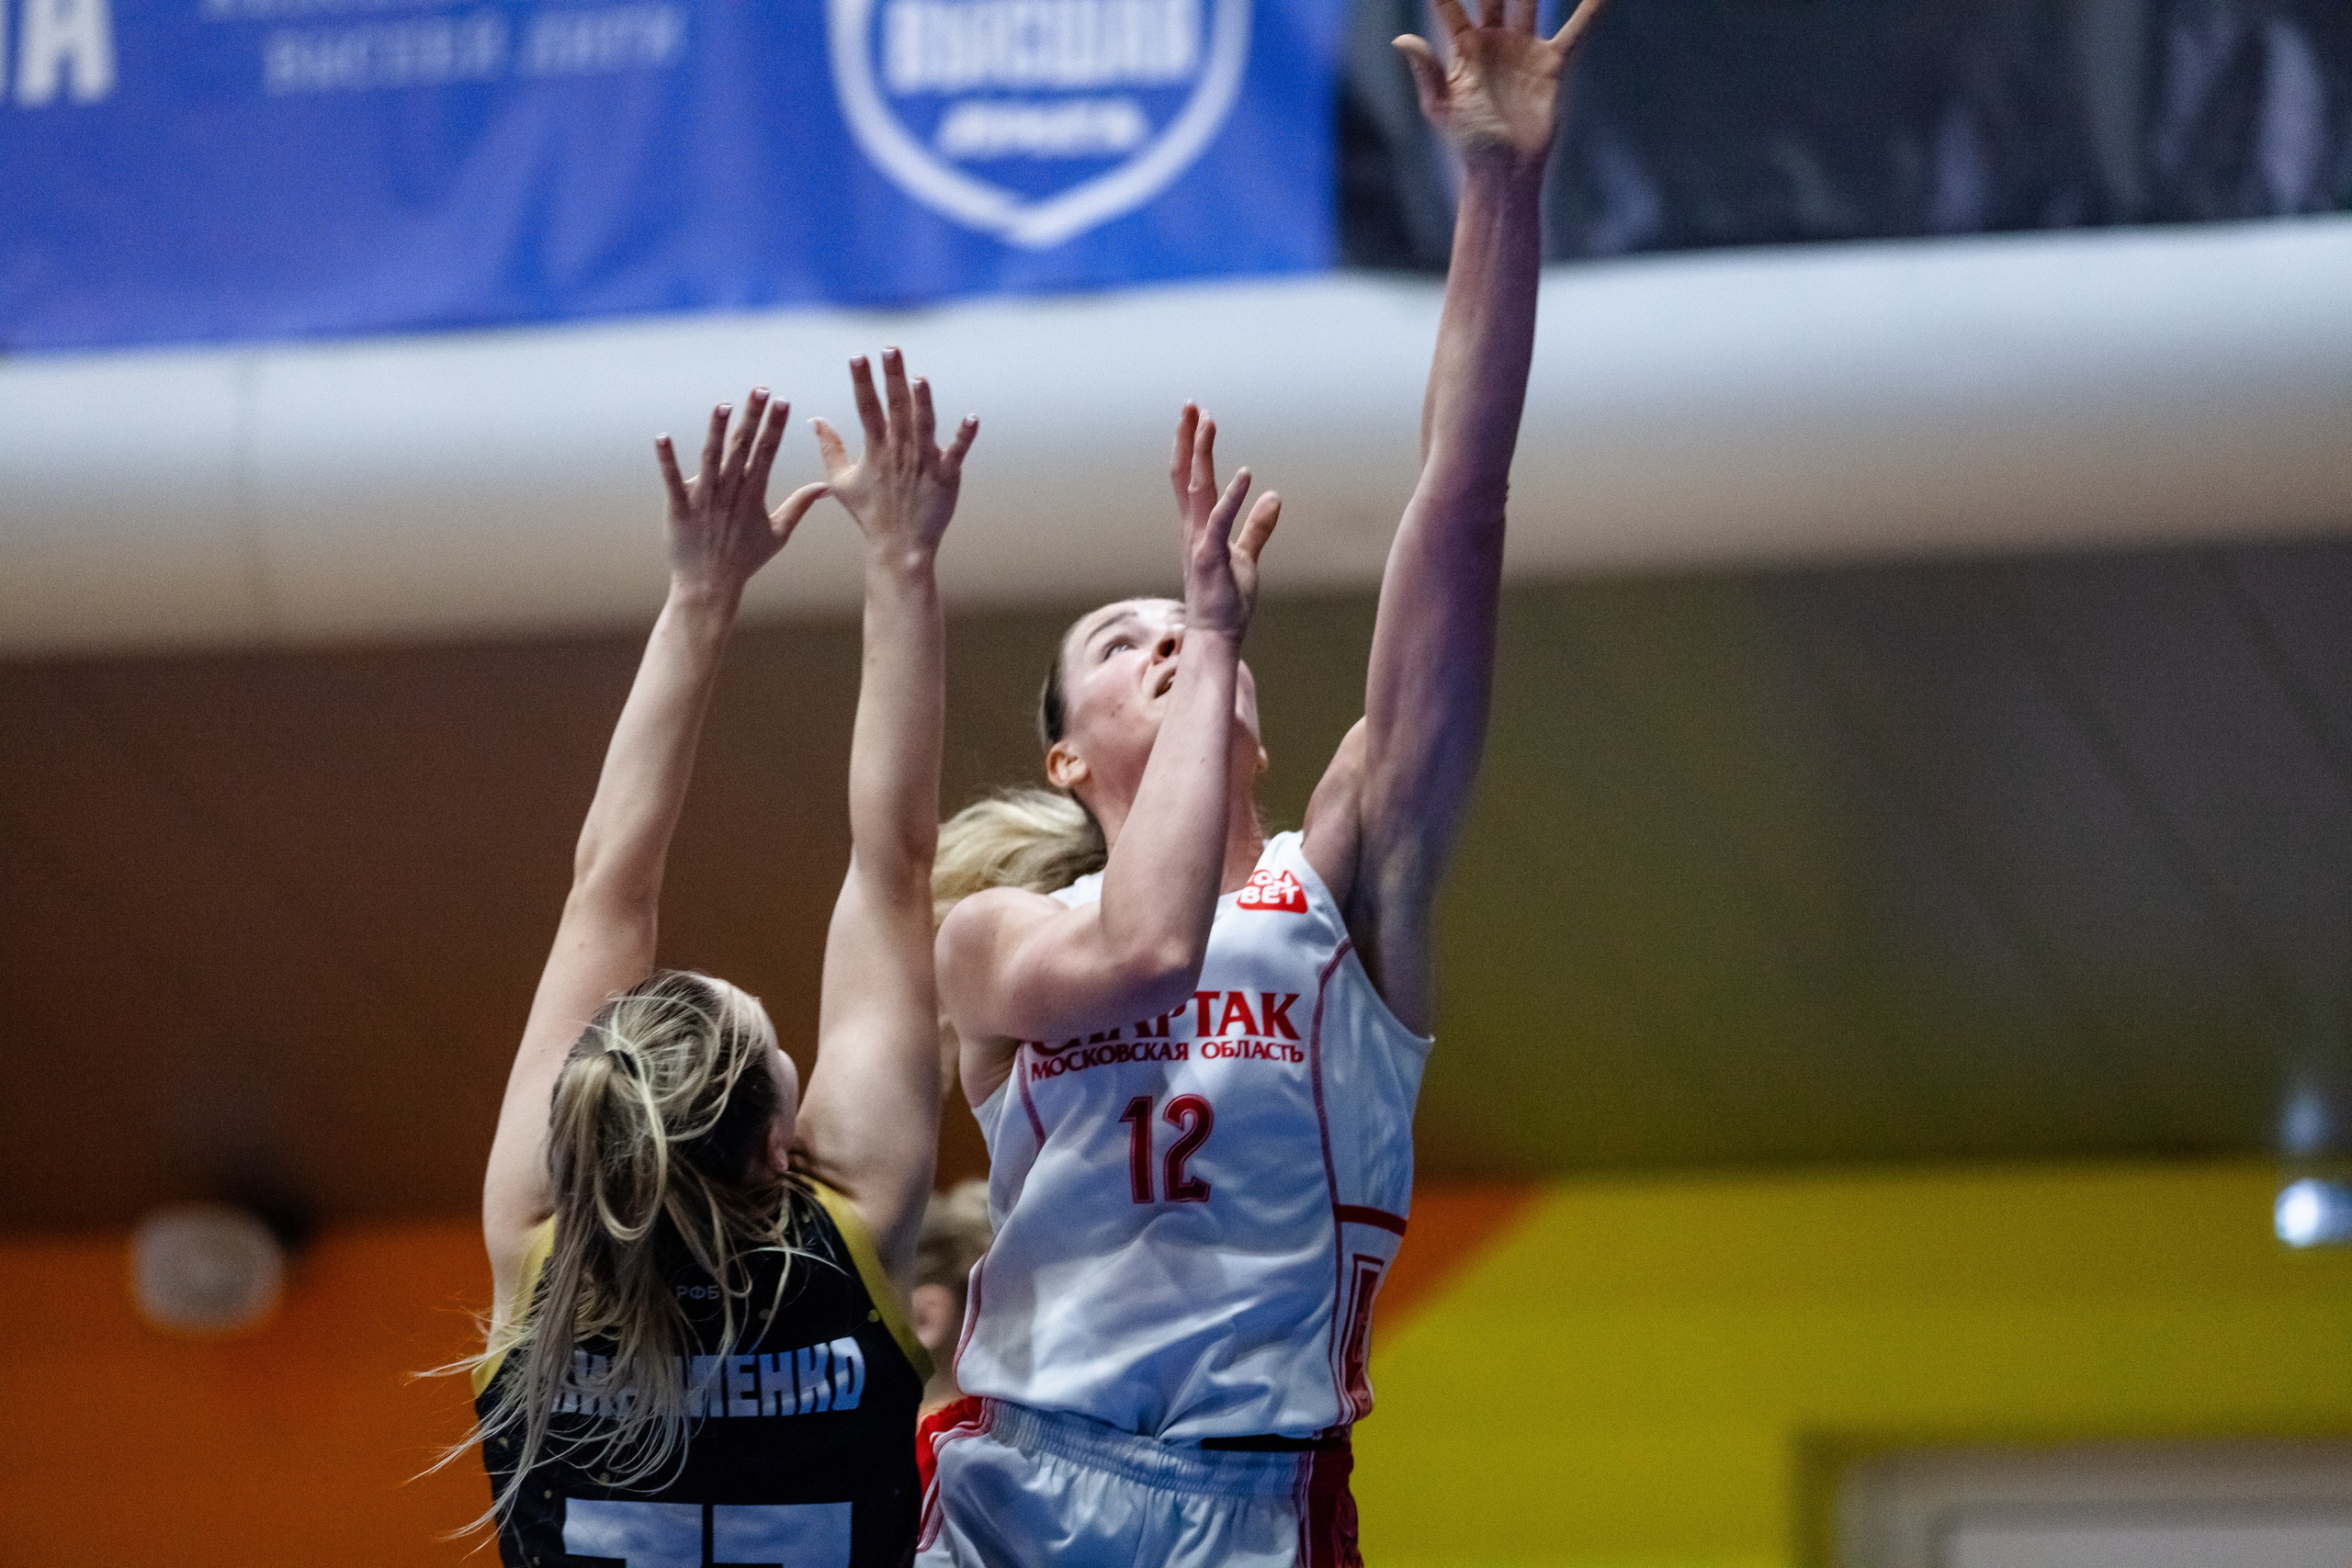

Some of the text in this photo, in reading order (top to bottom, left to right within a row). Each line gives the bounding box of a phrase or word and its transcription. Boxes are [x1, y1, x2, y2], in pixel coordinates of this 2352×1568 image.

[1031, 1040, 1305, 1081] МОСКОВСКАЯ ОБЛАСТЬ
[1118, 1092, 1215, 1204] 12
[676, 1285, 720, 1300] РФБ
